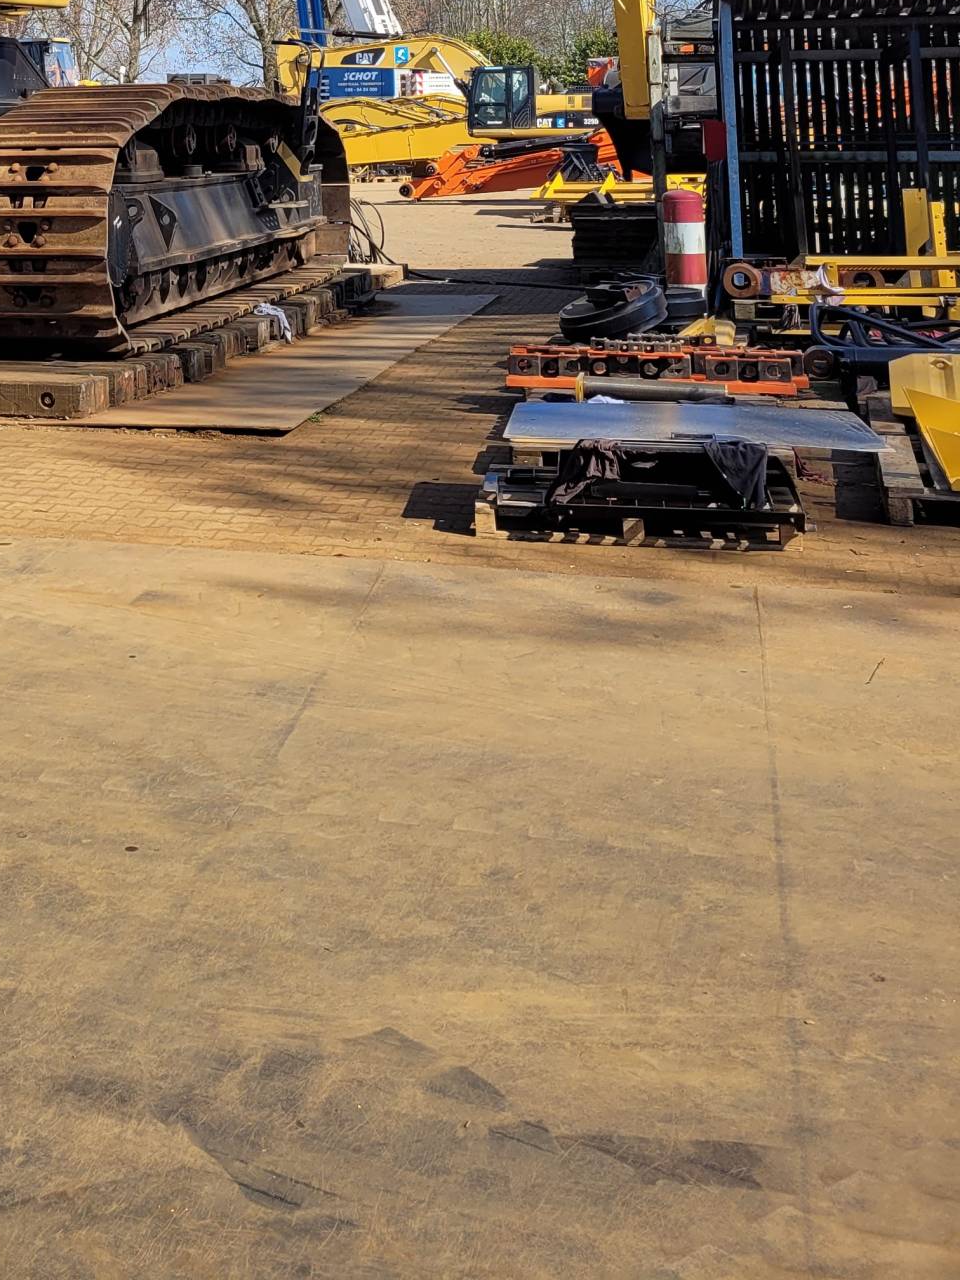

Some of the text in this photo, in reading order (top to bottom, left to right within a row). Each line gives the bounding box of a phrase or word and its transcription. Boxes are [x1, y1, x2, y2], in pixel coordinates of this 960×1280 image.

[355, 52, 374, 65] CAT
[343, 71, 379, 81] SCHOT
[536, 118, 553, 128] CAT
